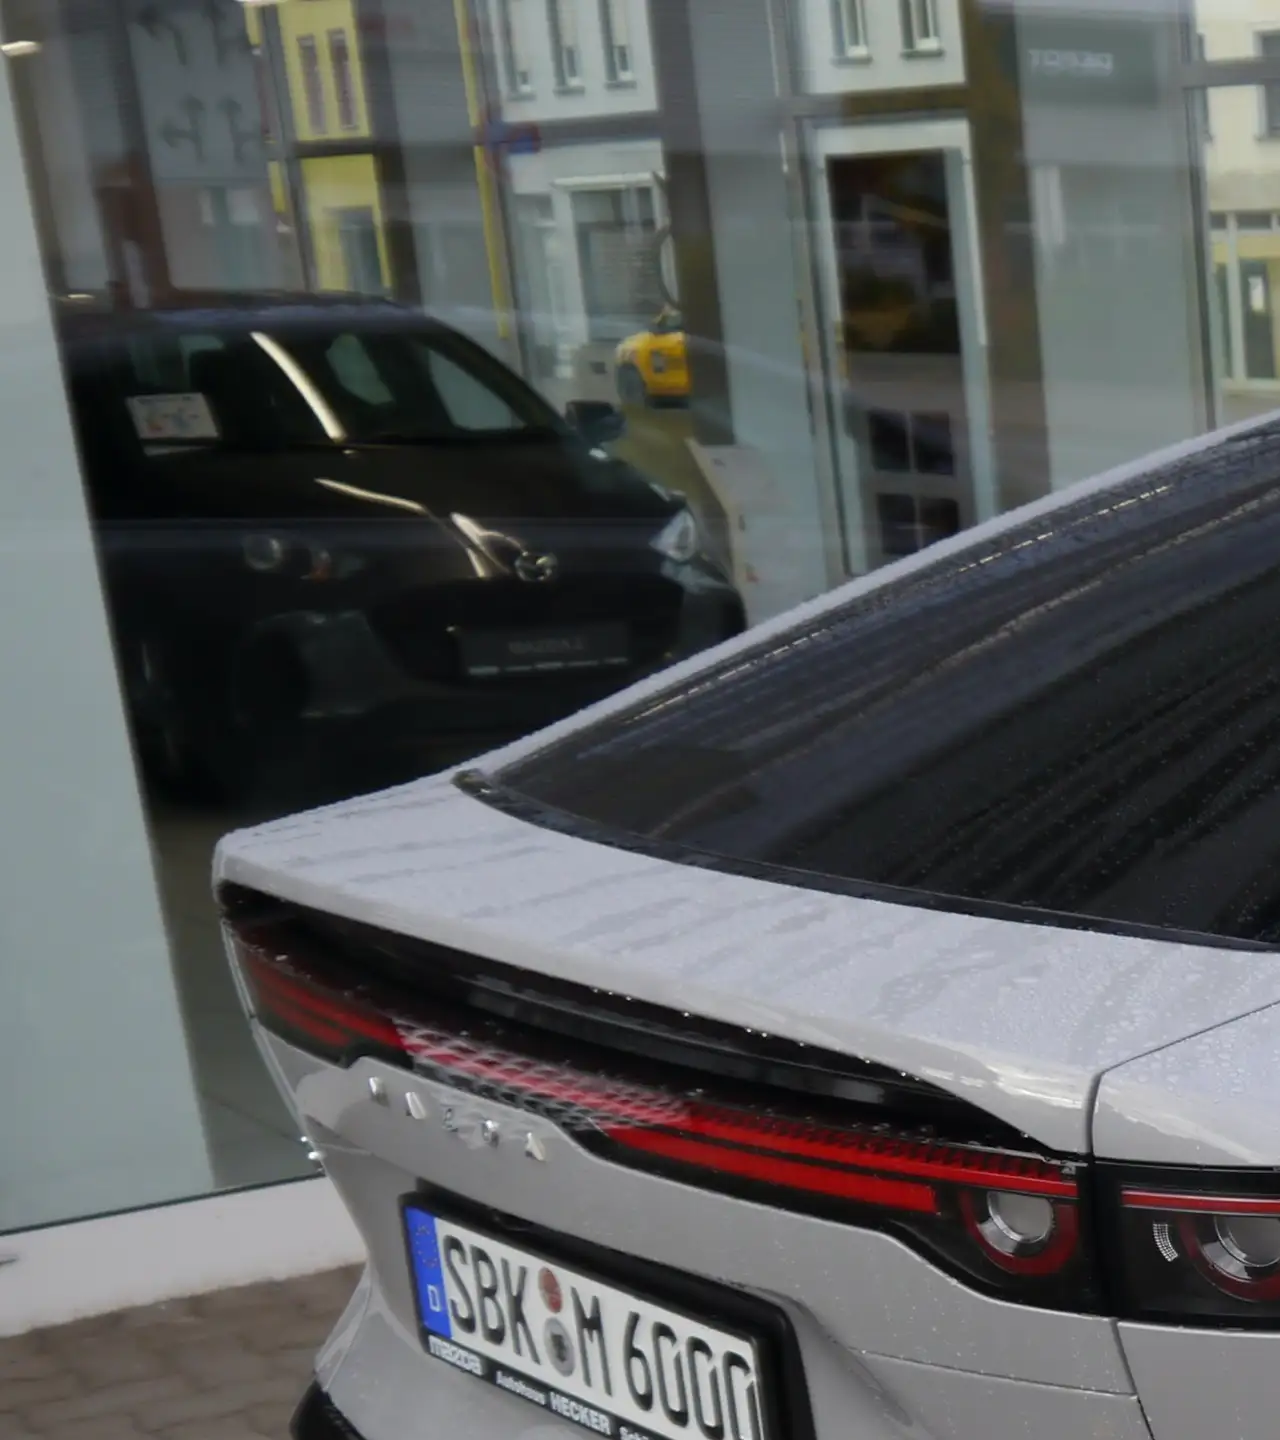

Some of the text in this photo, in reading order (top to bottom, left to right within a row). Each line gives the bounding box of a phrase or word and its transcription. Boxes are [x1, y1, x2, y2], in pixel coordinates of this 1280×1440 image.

[427, 1284, 441, 1312] D
[442, 1234, 542, 1366] SBK
[570, 1286, 614, 1397] M
[496, 1370, 546, 1406] Autohaus
[549, 1391, 611, 1436] HECKER
